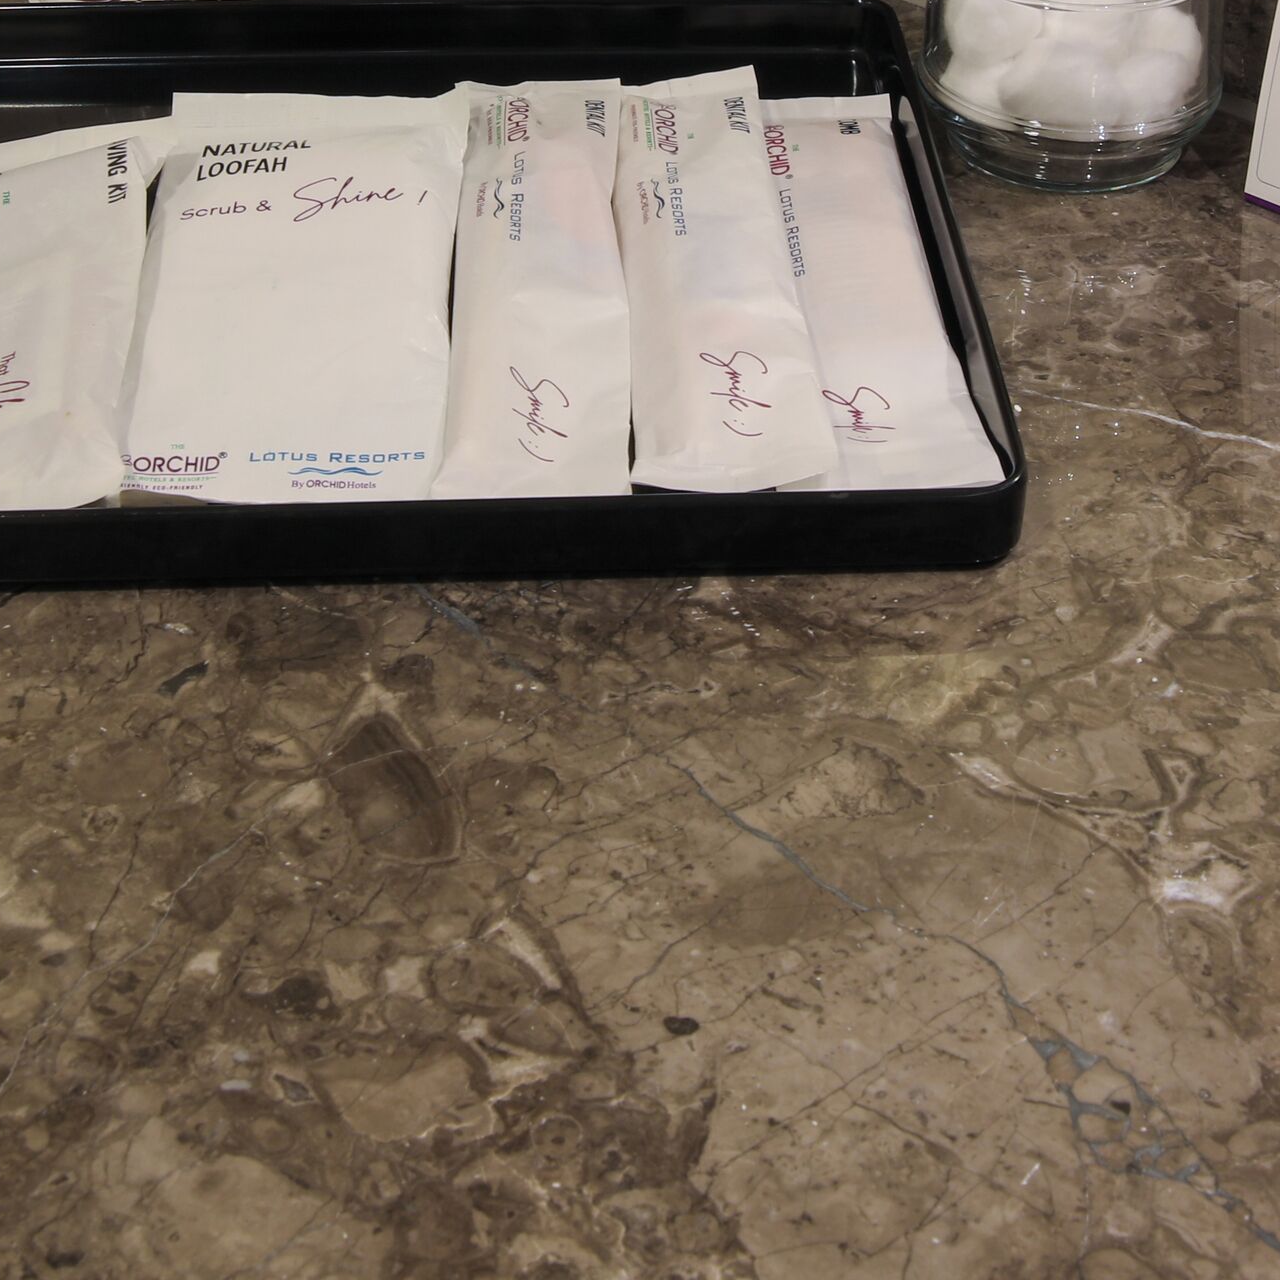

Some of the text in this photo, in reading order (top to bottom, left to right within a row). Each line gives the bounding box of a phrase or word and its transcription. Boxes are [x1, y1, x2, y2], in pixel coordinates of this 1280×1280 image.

[584, 99, 606, 137] DENTAL KIT
[724, 96, 750, 134] DENTAL KIT
[202, 140, 312, 158] NATURAL
[196, 156, 288, 182] LOOFAH
[107, 183, 127, 204] KIT
[256, 200, 272, 212] &
[293, 176, 404, 222] Shine
[510, 151, 526, 241] LOTUS RESORTS
[665, 161, 686, 237] LOTUS RESORTS
[779, 188, 806, 278] LOTUS RESORTS
[249, 451, 425, 463] LOTUS RESORTS
[291, 480, 304, 489] By
